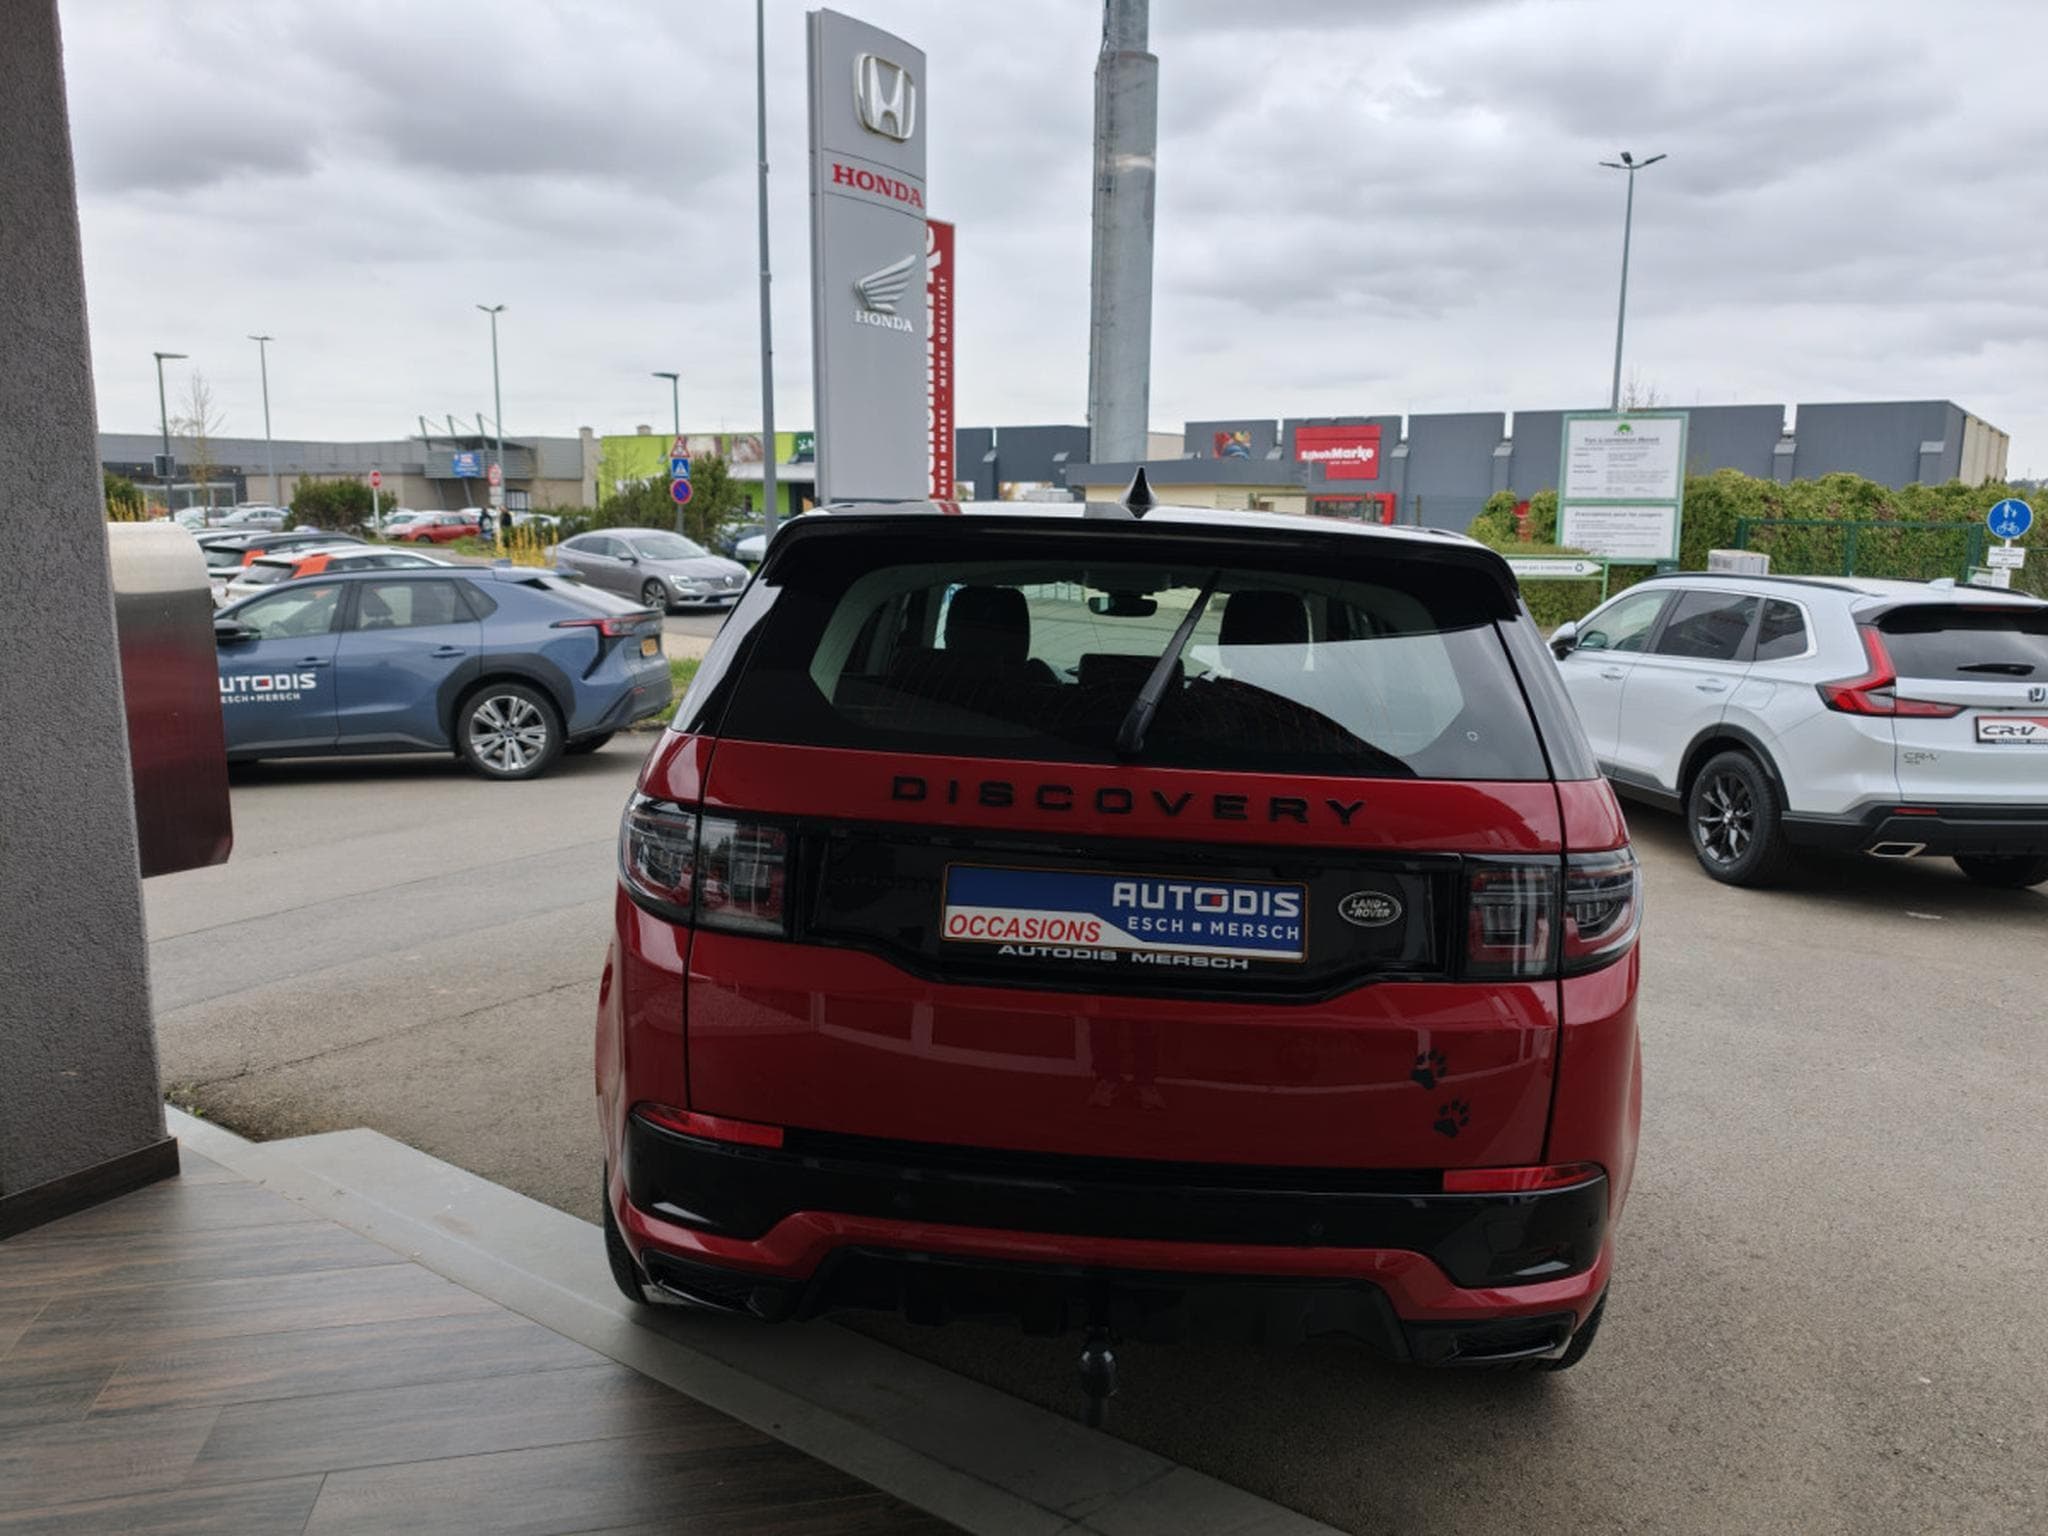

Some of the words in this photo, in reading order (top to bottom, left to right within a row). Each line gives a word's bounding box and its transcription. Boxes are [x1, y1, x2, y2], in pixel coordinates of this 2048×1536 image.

[832, 162, 924, 208] HONDA
[855, 309, 914, 332] HONDA
[940, 408, 948, 453] MARKE
[940, 460, 948, 495] MEHR
[219, 673, 317, 693] UTODIS
[220, 695, 249, 704] ESCH
[256, 692, 301, 703] MERSCH
[1981, 724, 2037, 737] CR-V
[890, 774, 1366, 826] DISCOVERY
[1112, 881, 1301, 918] AUTODIS
[948, 913, 1102, 943] OCCASIONS
[1127, 915, 1185, 934] ESCH
[1209, 921, 1301, 941] MERSCH
[997, 944, 1117, 962] AUTODIS
[1131, 952, 1249, 970] MERSCH
